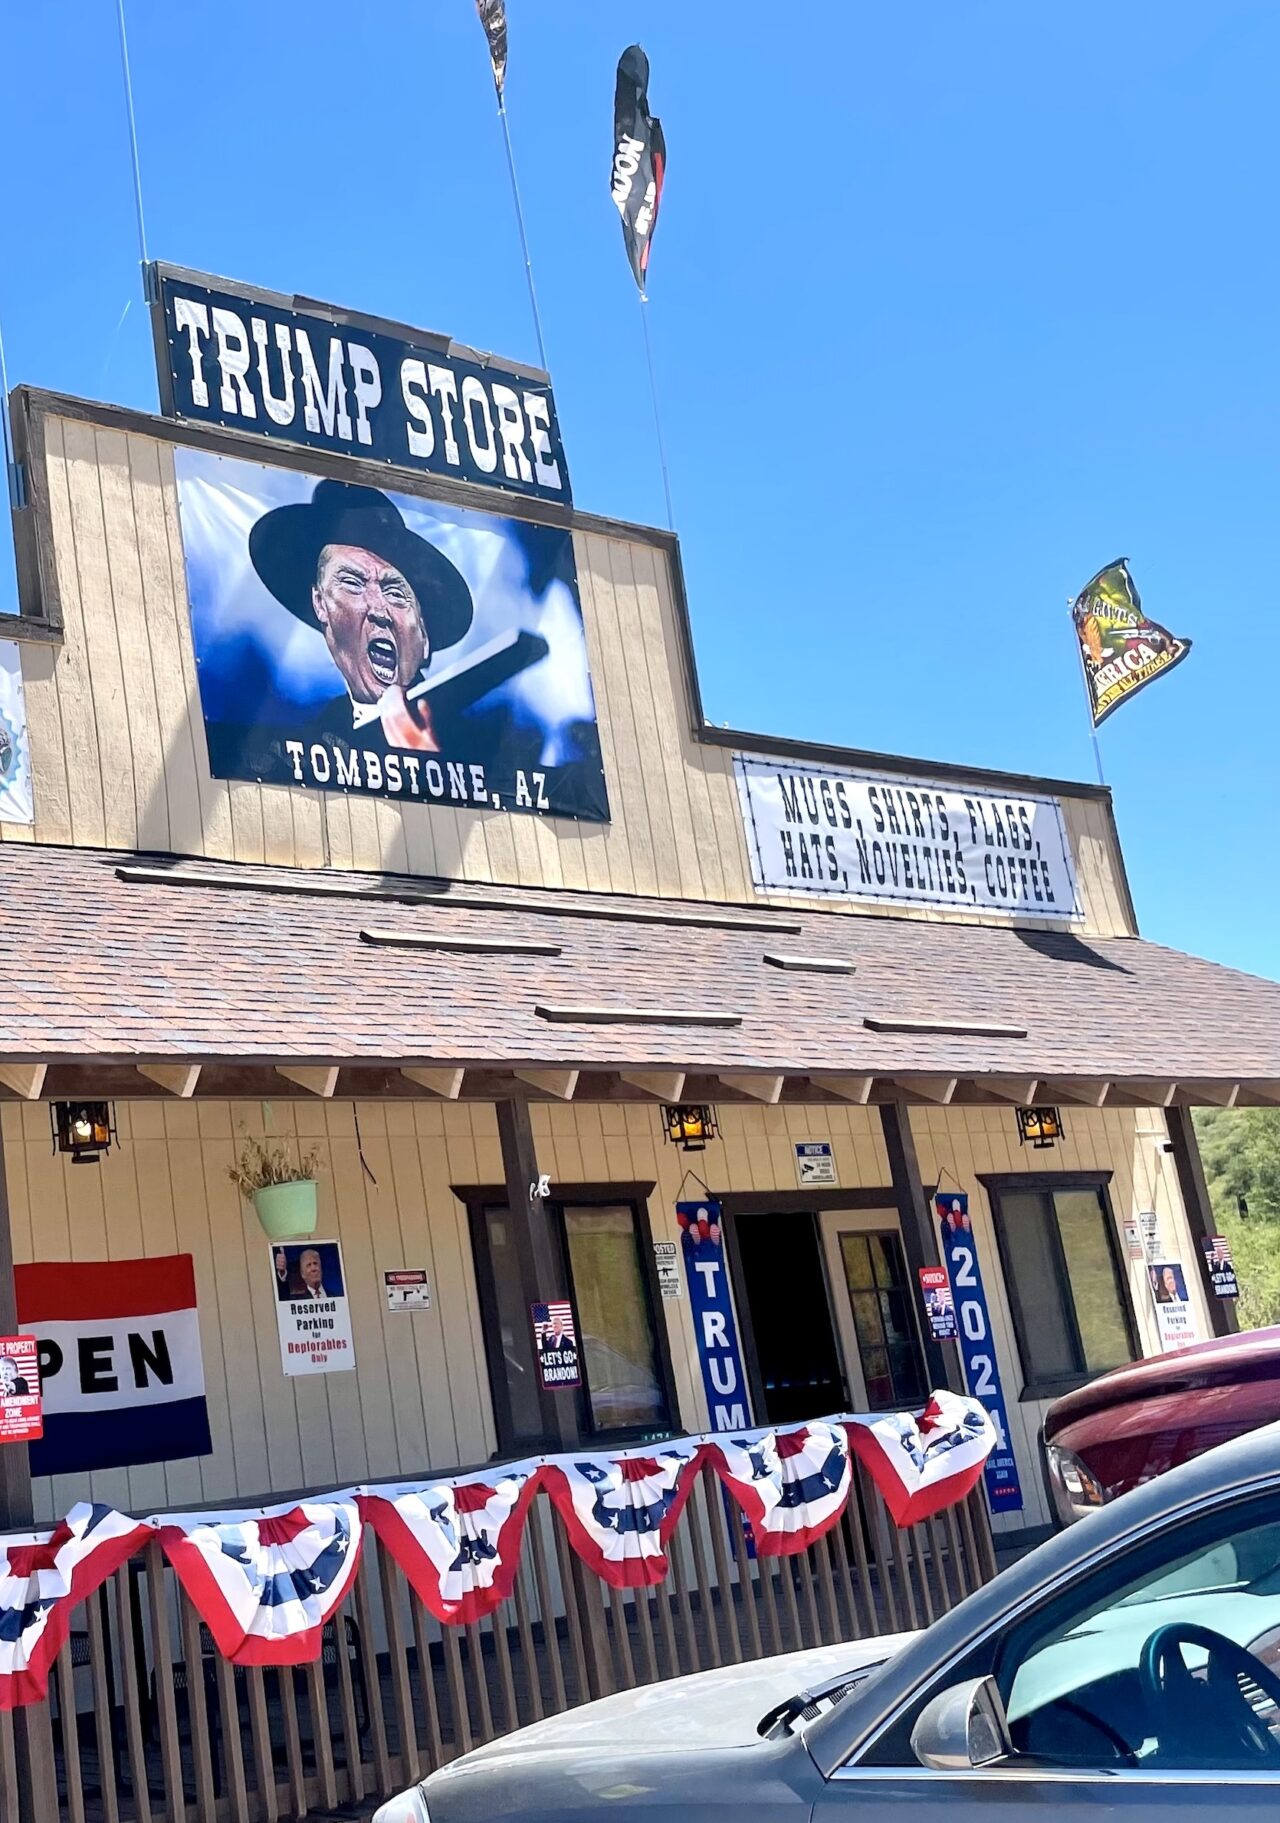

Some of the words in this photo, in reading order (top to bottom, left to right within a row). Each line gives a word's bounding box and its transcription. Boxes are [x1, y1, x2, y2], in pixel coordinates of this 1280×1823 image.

[174, 296, 381, 446] TRUMP
[400, 356, 562, 490] STORE
[286, 739, 501, 810] TOMBSTONE,
[516, 769, 550, 810] AZ
[777, 773, 864, 839] MUGS,
[868, 785, 959, 851] SHIRTS,
[965, 798, 1041, 863] FLAGS,
[780, 830, 849, 890] HATS,
[856, 838, 977, 902] NOVELTIES,
[984, 853, 1055, 902] COFFEE
[290, 1301, 336, 1315] Reserved
[296, 1318, 334, 1331] Parking
[6, 1340, 35, 1354] PROPERTY
[288, 1339, 347, 1354] Deplorables
[694, 1261, 747, 1432] TRUM
[543, 1352, 563, 1366] LET'S
[563, 1350, 574, 1364] GO
[543, 1366, 578, 1382] BRANDON!
[5, 1408, 23, 1418] ZONE
